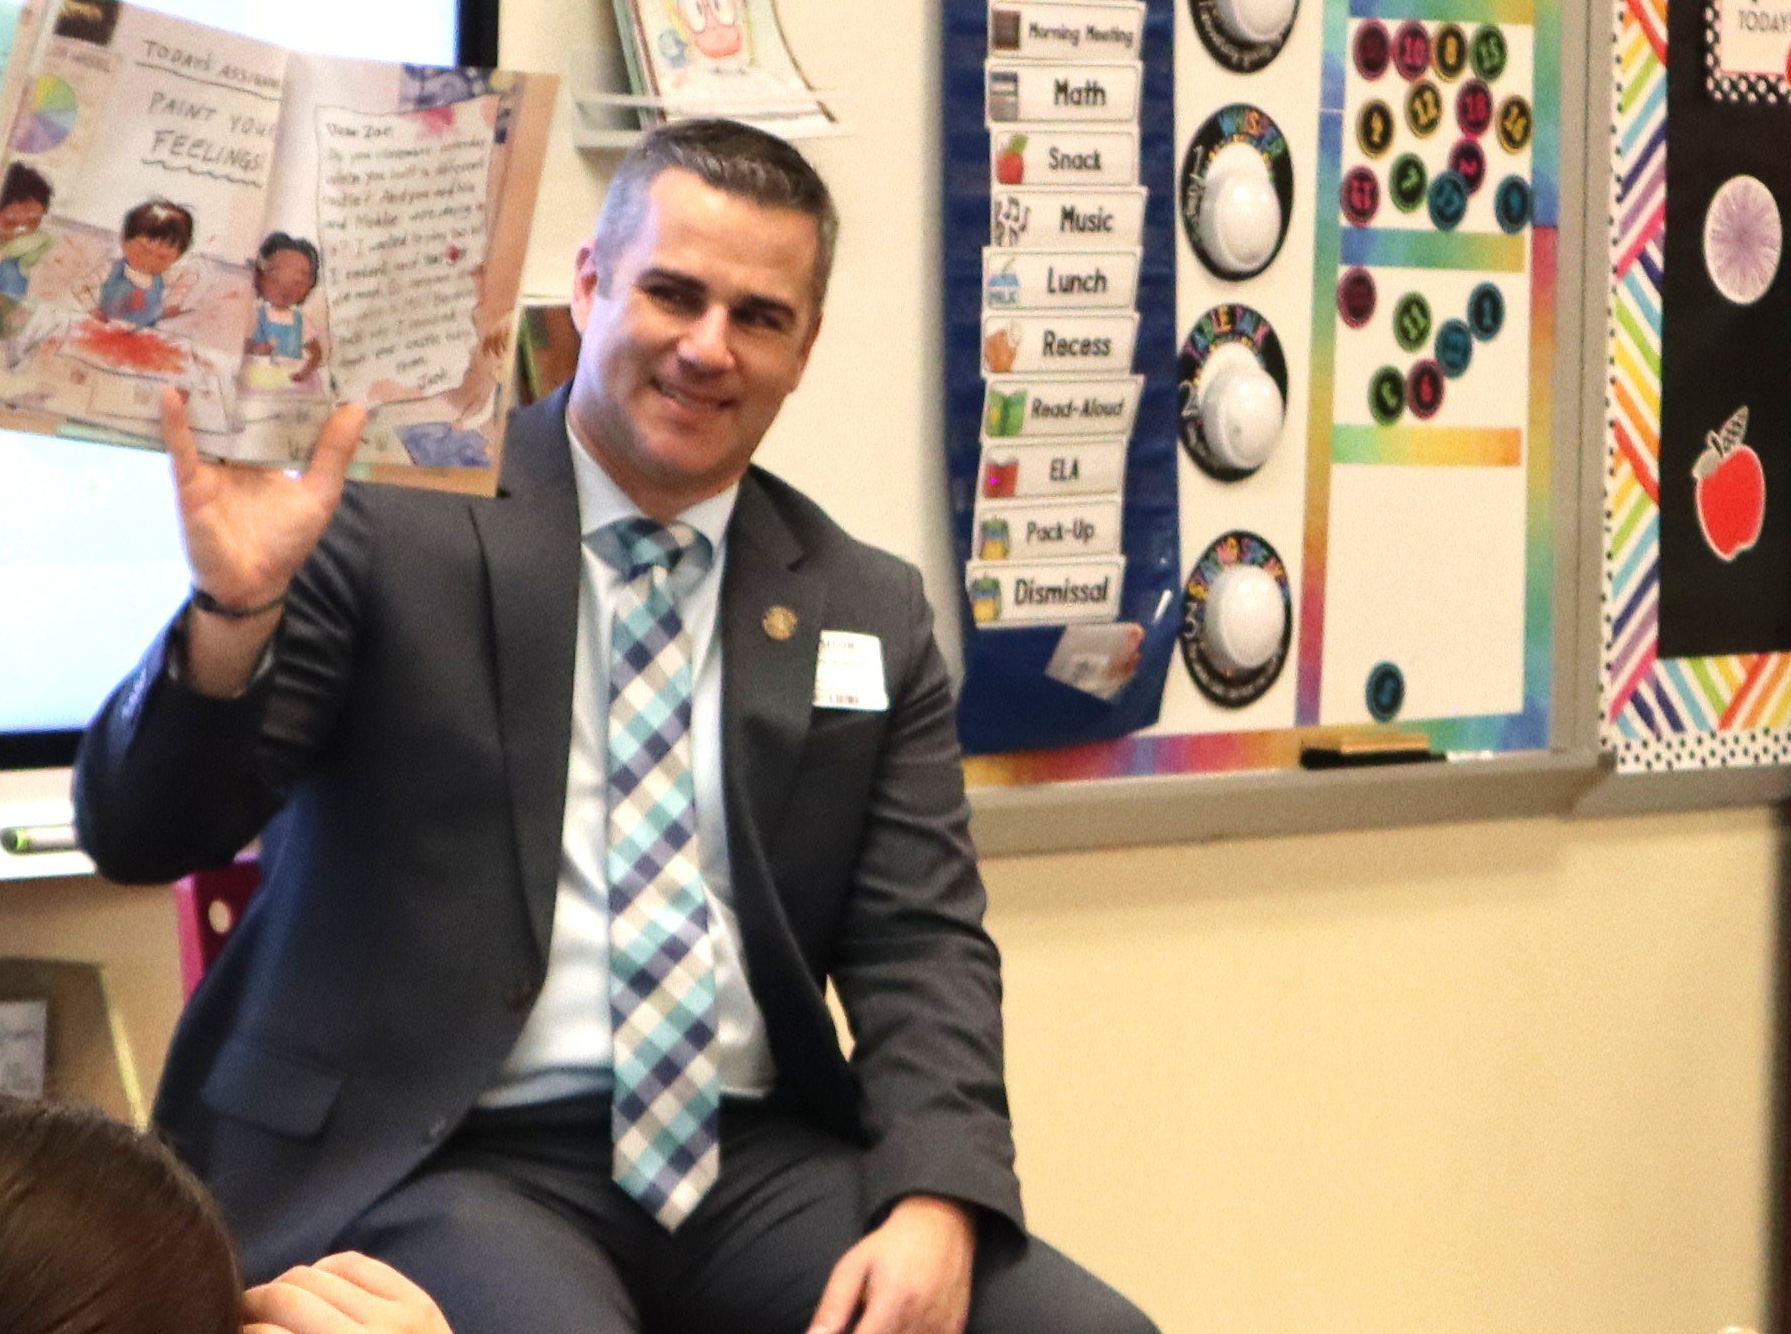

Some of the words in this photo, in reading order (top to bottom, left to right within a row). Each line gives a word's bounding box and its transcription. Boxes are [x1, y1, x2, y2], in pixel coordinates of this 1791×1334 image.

[1027, 19, 1082, 45] Morning
[1084, 22, 1135, 48] Meeting
[147, 90, 219, 122] PAINT
[1052, 78, 1108, 107] Math
[151, 128, 262, 173] FEELINGS
[1047, 144, 1104, 171] Snack
[1059, 206, 1115, 234] Music
[1046, 267, 1108, 297] Lunch
[1042, 329, 1113, 358] Recess
[1030, 395, 1125, 421] Read-Aloud
[1049, 456, 1080, 483] ELA
[1025, 518, 1097, 546] Pack-Up
[1013, 575, 1109, 605] Dismissal
